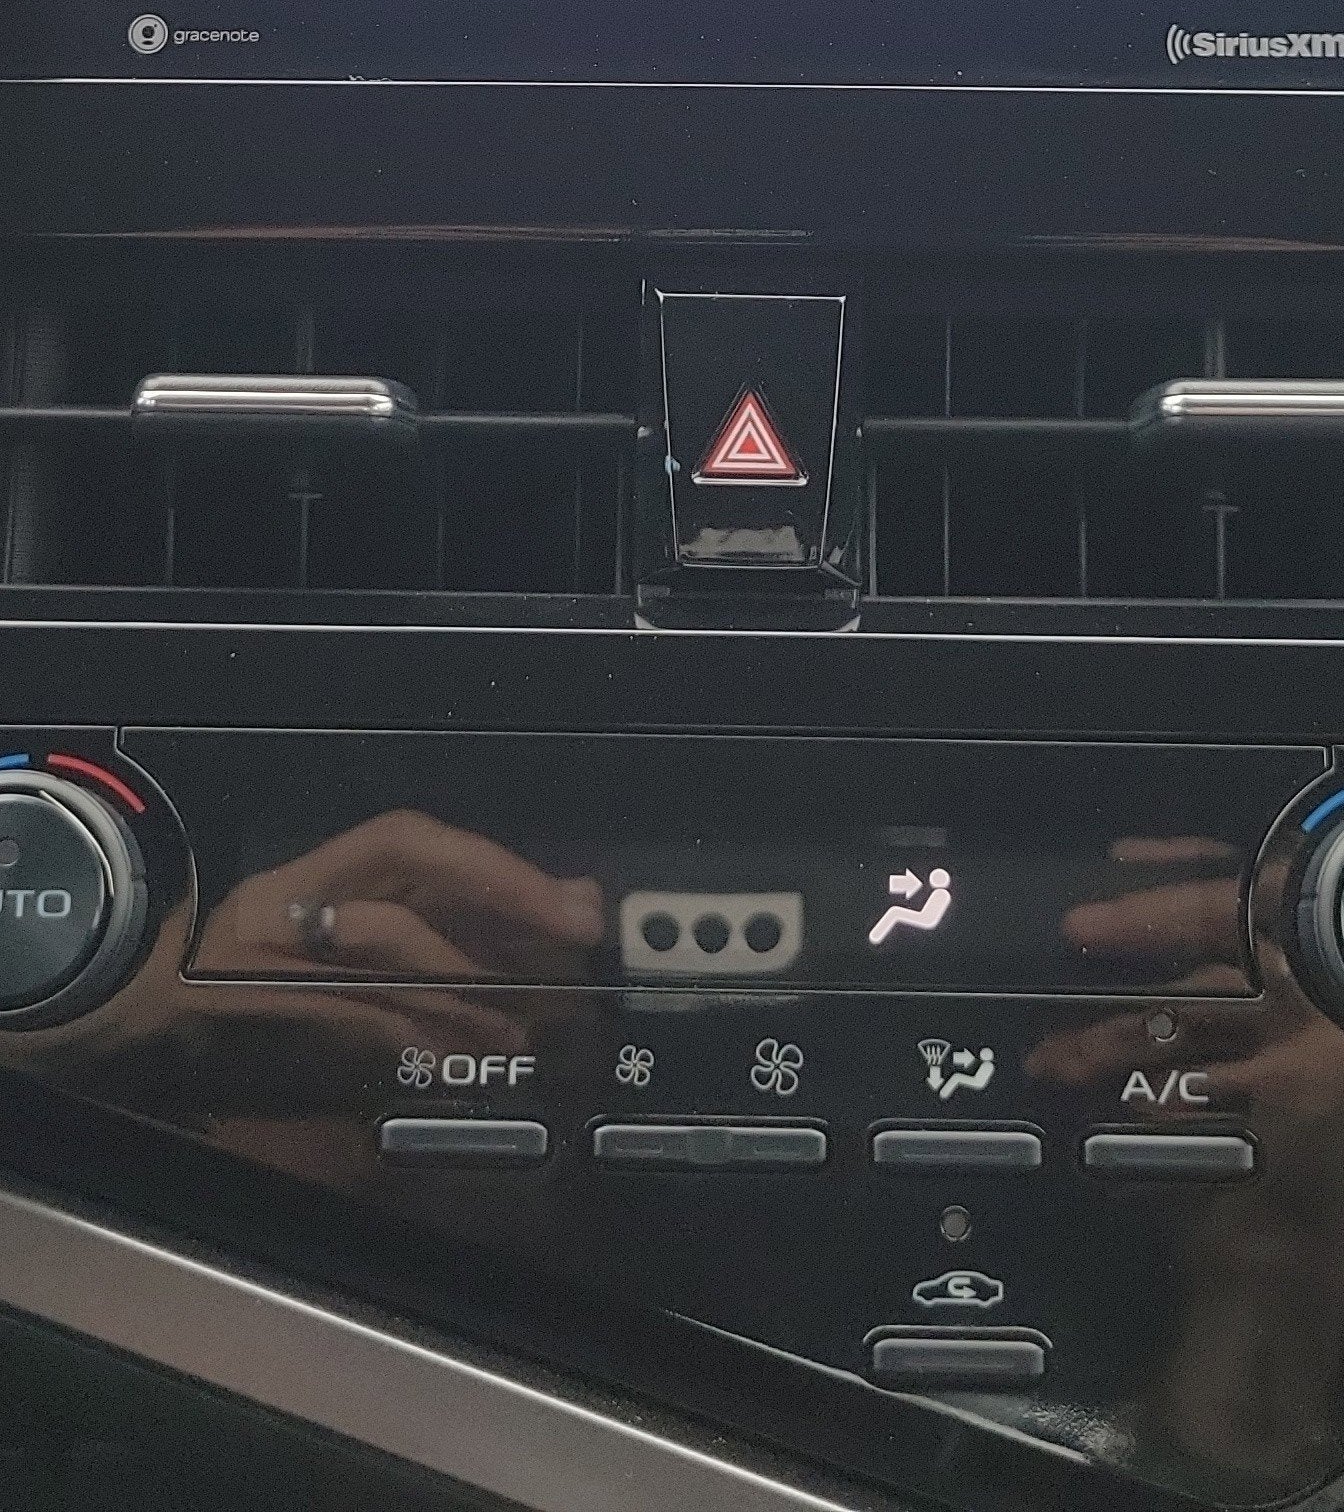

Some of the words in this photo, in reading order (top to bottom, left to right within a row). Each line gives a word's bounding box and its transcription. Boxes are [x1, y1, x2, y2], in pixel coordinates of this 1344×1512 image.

[173, 29, 260, 45] gracenote
[442, 1053, 536, 1086] OFF
[1120, 1068, 1210, 1105] A/C
